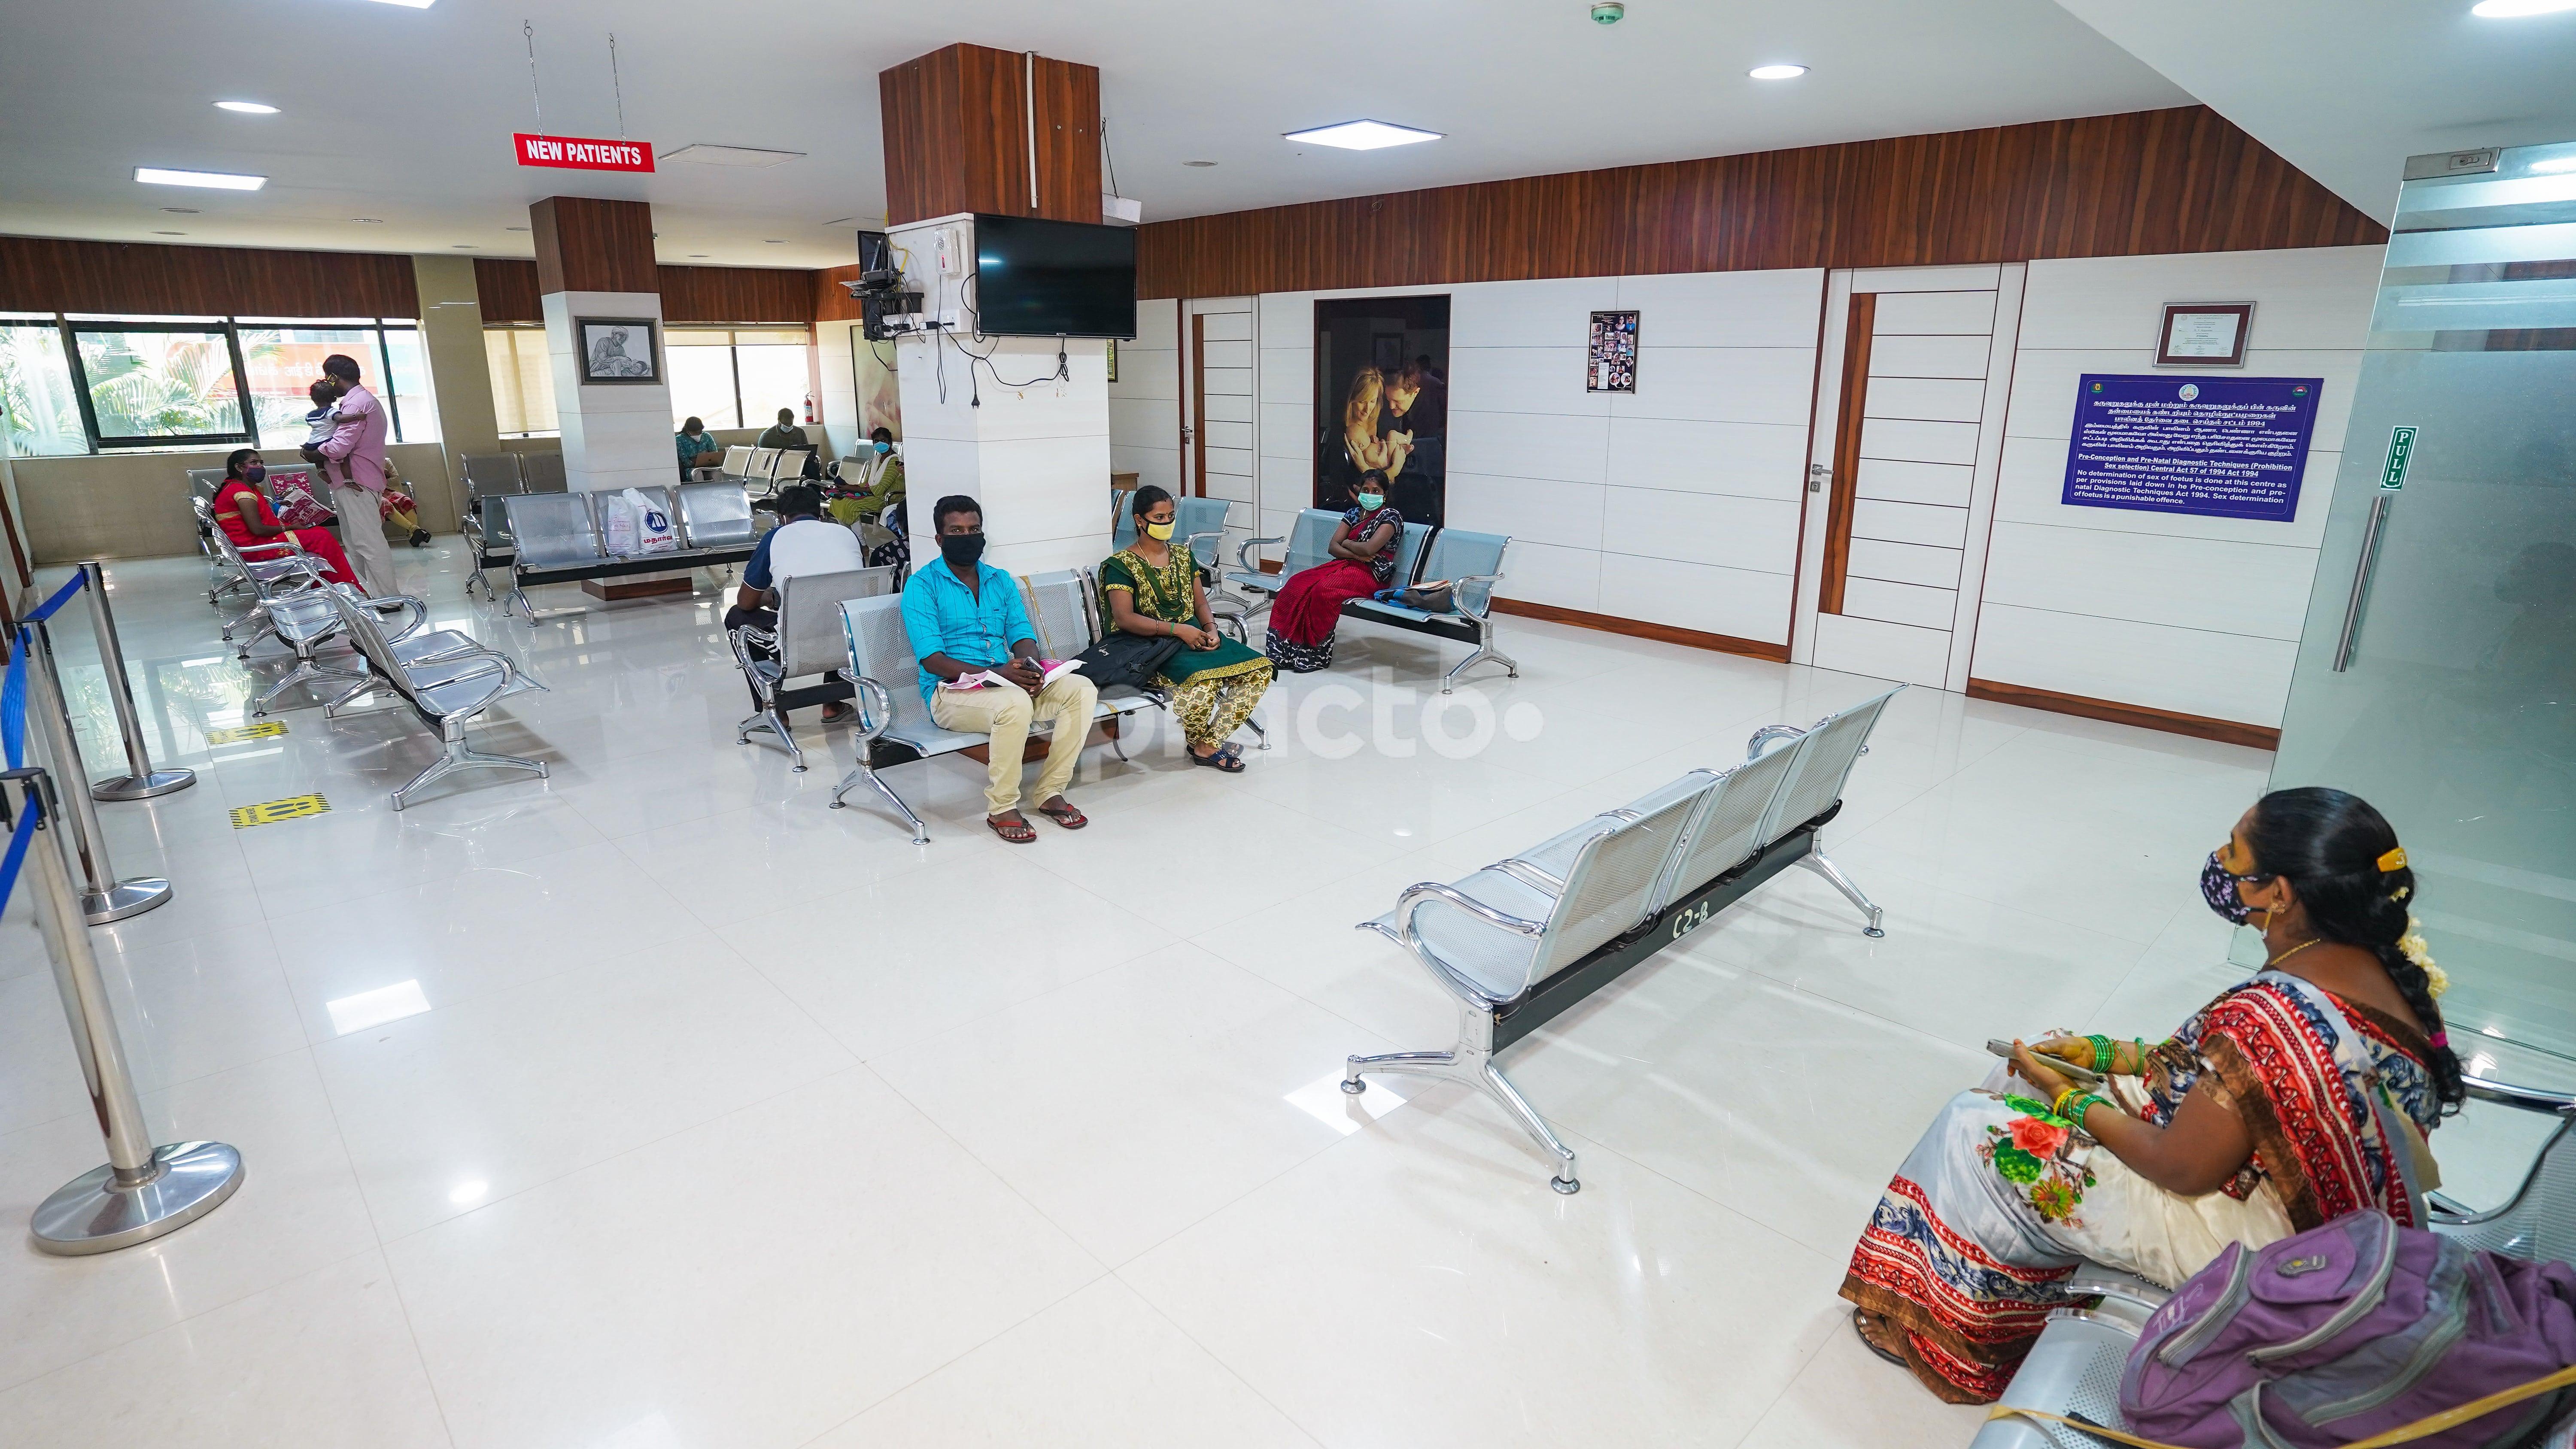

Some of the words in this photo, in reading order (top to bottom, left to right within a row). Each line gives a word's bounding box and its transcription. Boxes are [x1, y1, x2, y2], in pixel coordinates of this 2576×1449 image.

[526, 140, 562, 161] NEW
[566, 143, 641, 165] PATIENTS
[2388, 432, 2409, 482] PULL
[2089, 470, 2136, 478] determination
[2133, 488, 2173, 496] Techniques
[2230, 494, 2284, 503] determination
[2190, 484, 2248, 493] Pre-conception
[1673, 901, 1708, 939] C2-8
